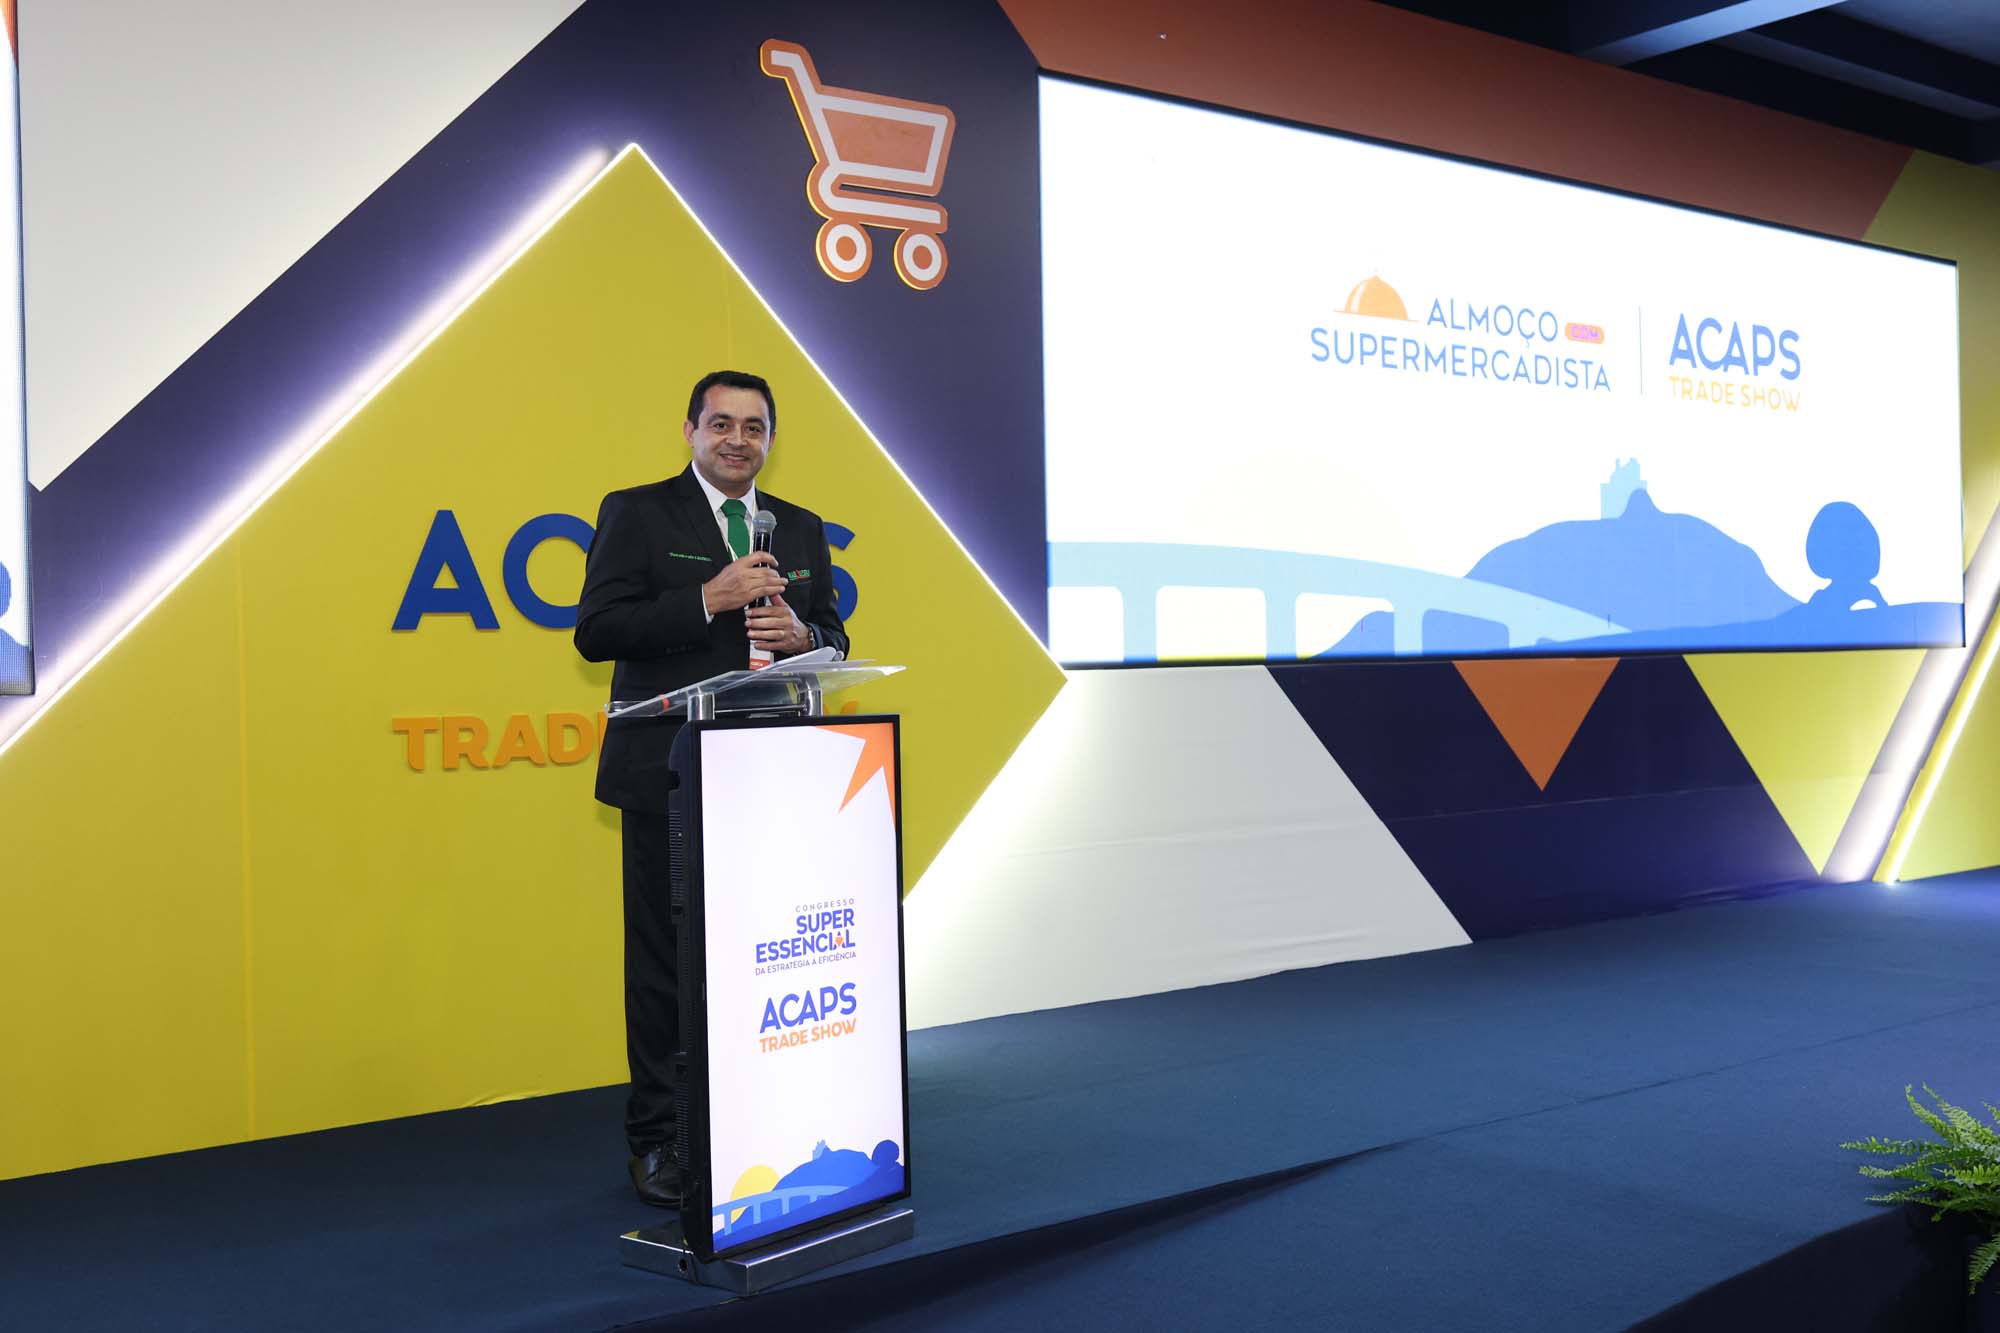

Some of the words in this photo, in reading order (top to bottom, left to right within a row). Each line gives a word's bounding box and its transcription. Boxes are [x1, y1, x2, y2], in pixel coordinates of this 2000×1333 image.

[1427, 298, 1558, 347] ALMOÇO
[1311, 327, 1611, 392] SUPERMERCADISTA
[1669, 313, 1801, 380] ACAPS
[1669, 375, 1735, 405] TRADE
[1741, 384, 1801, 412] SHOW
[392, 711, 609, 773] TRAD
[795, 898, 855, 912] CONGRESSO
[796, 908, 855, 935] SUPER
[756, 929, 856, 964] ESSENCIAL
[755, 967, 766, 976] DA
[760, 982, 857, 1034] ACAPS
[759, 1029, 808, 1053] TRADE
[811, 1018, 857, 1042] SHOW
